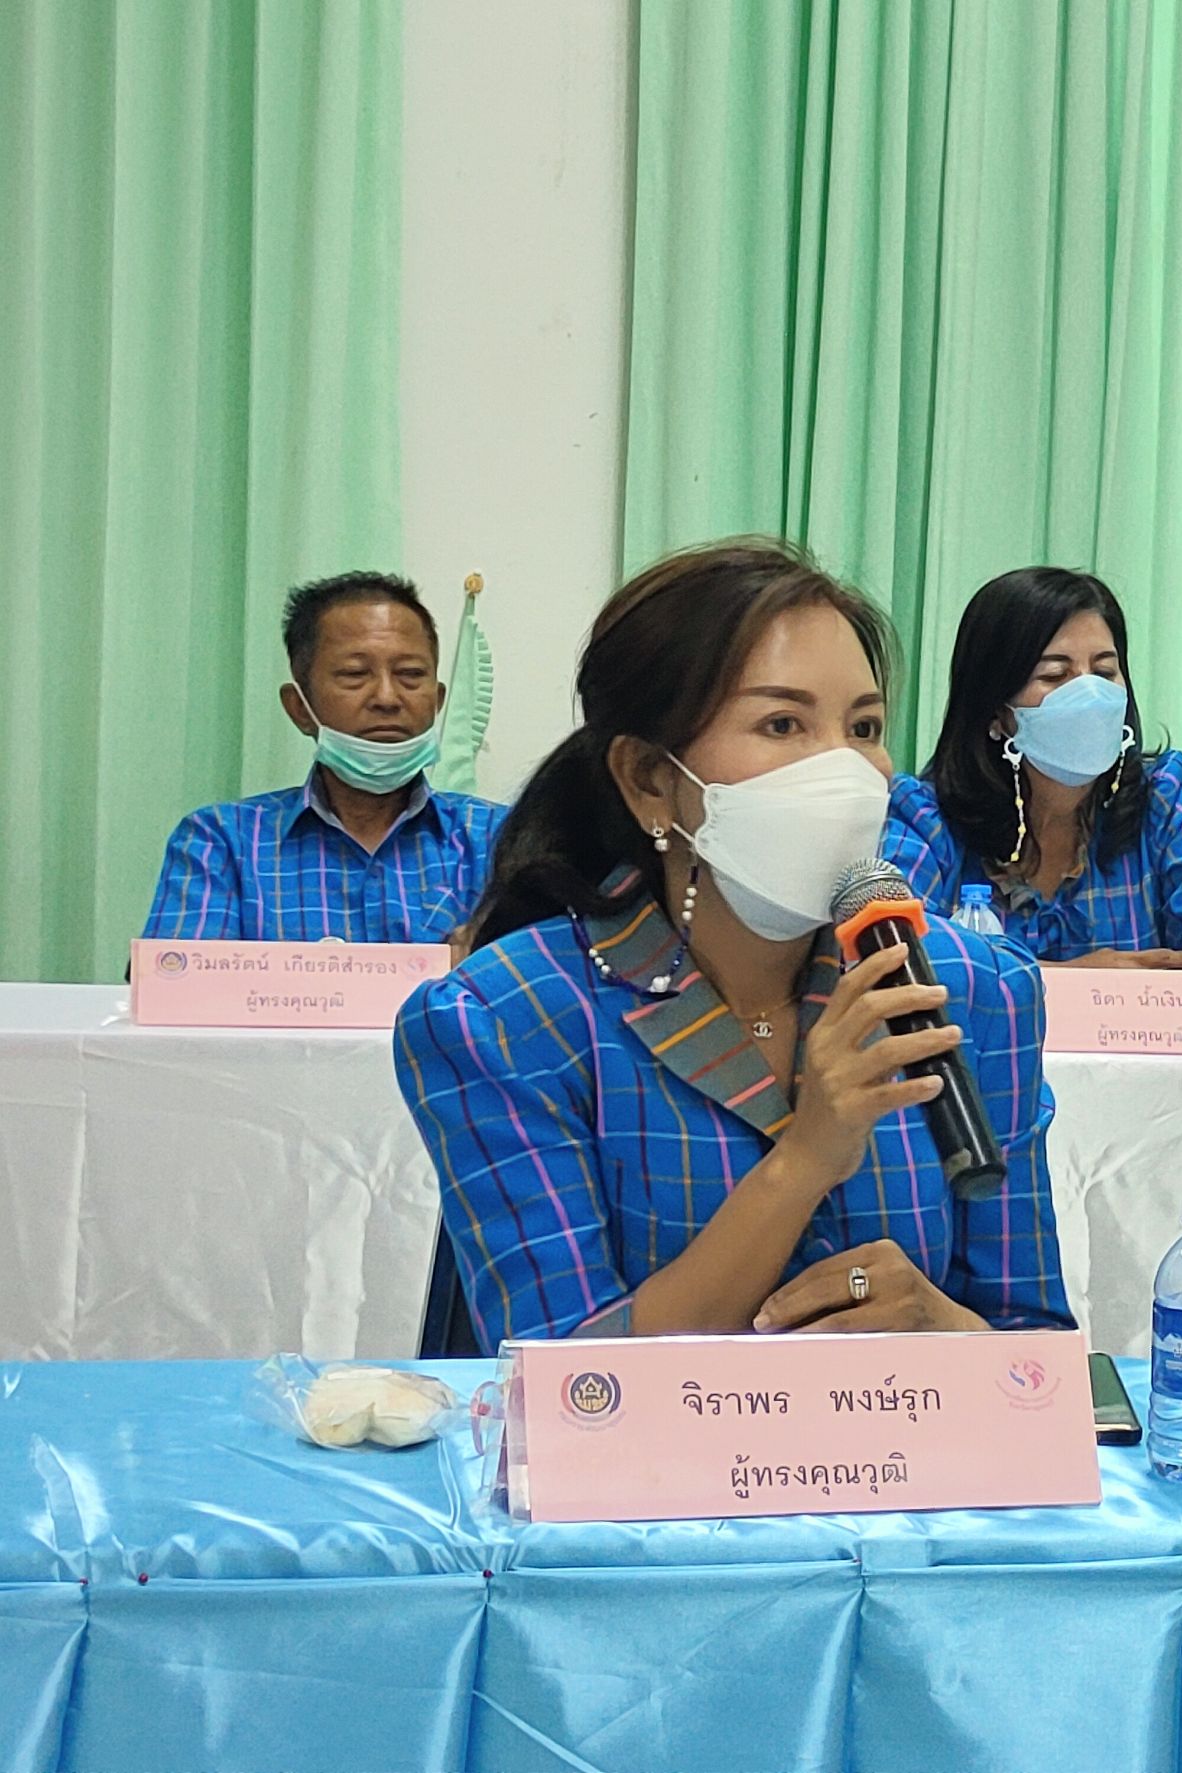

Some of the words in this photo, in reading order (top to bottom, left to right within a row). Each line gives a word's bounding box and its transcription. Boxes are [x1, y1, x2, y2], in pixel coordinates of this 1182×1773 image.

[191, 952, 269, 971] วิมลรัตน์
[284, 954, 397, 975] เกียรติสำรอง
[246, 989, 345, 1013] ผู้ทรงคุณวุฒิ
[681, 1380, 791, 1416] จิราพร
[829, 1373, 941, 1423] พงษ์รุก
[730, 1451, 909, 1499] ผู้ทรงคุณวุฒิ
